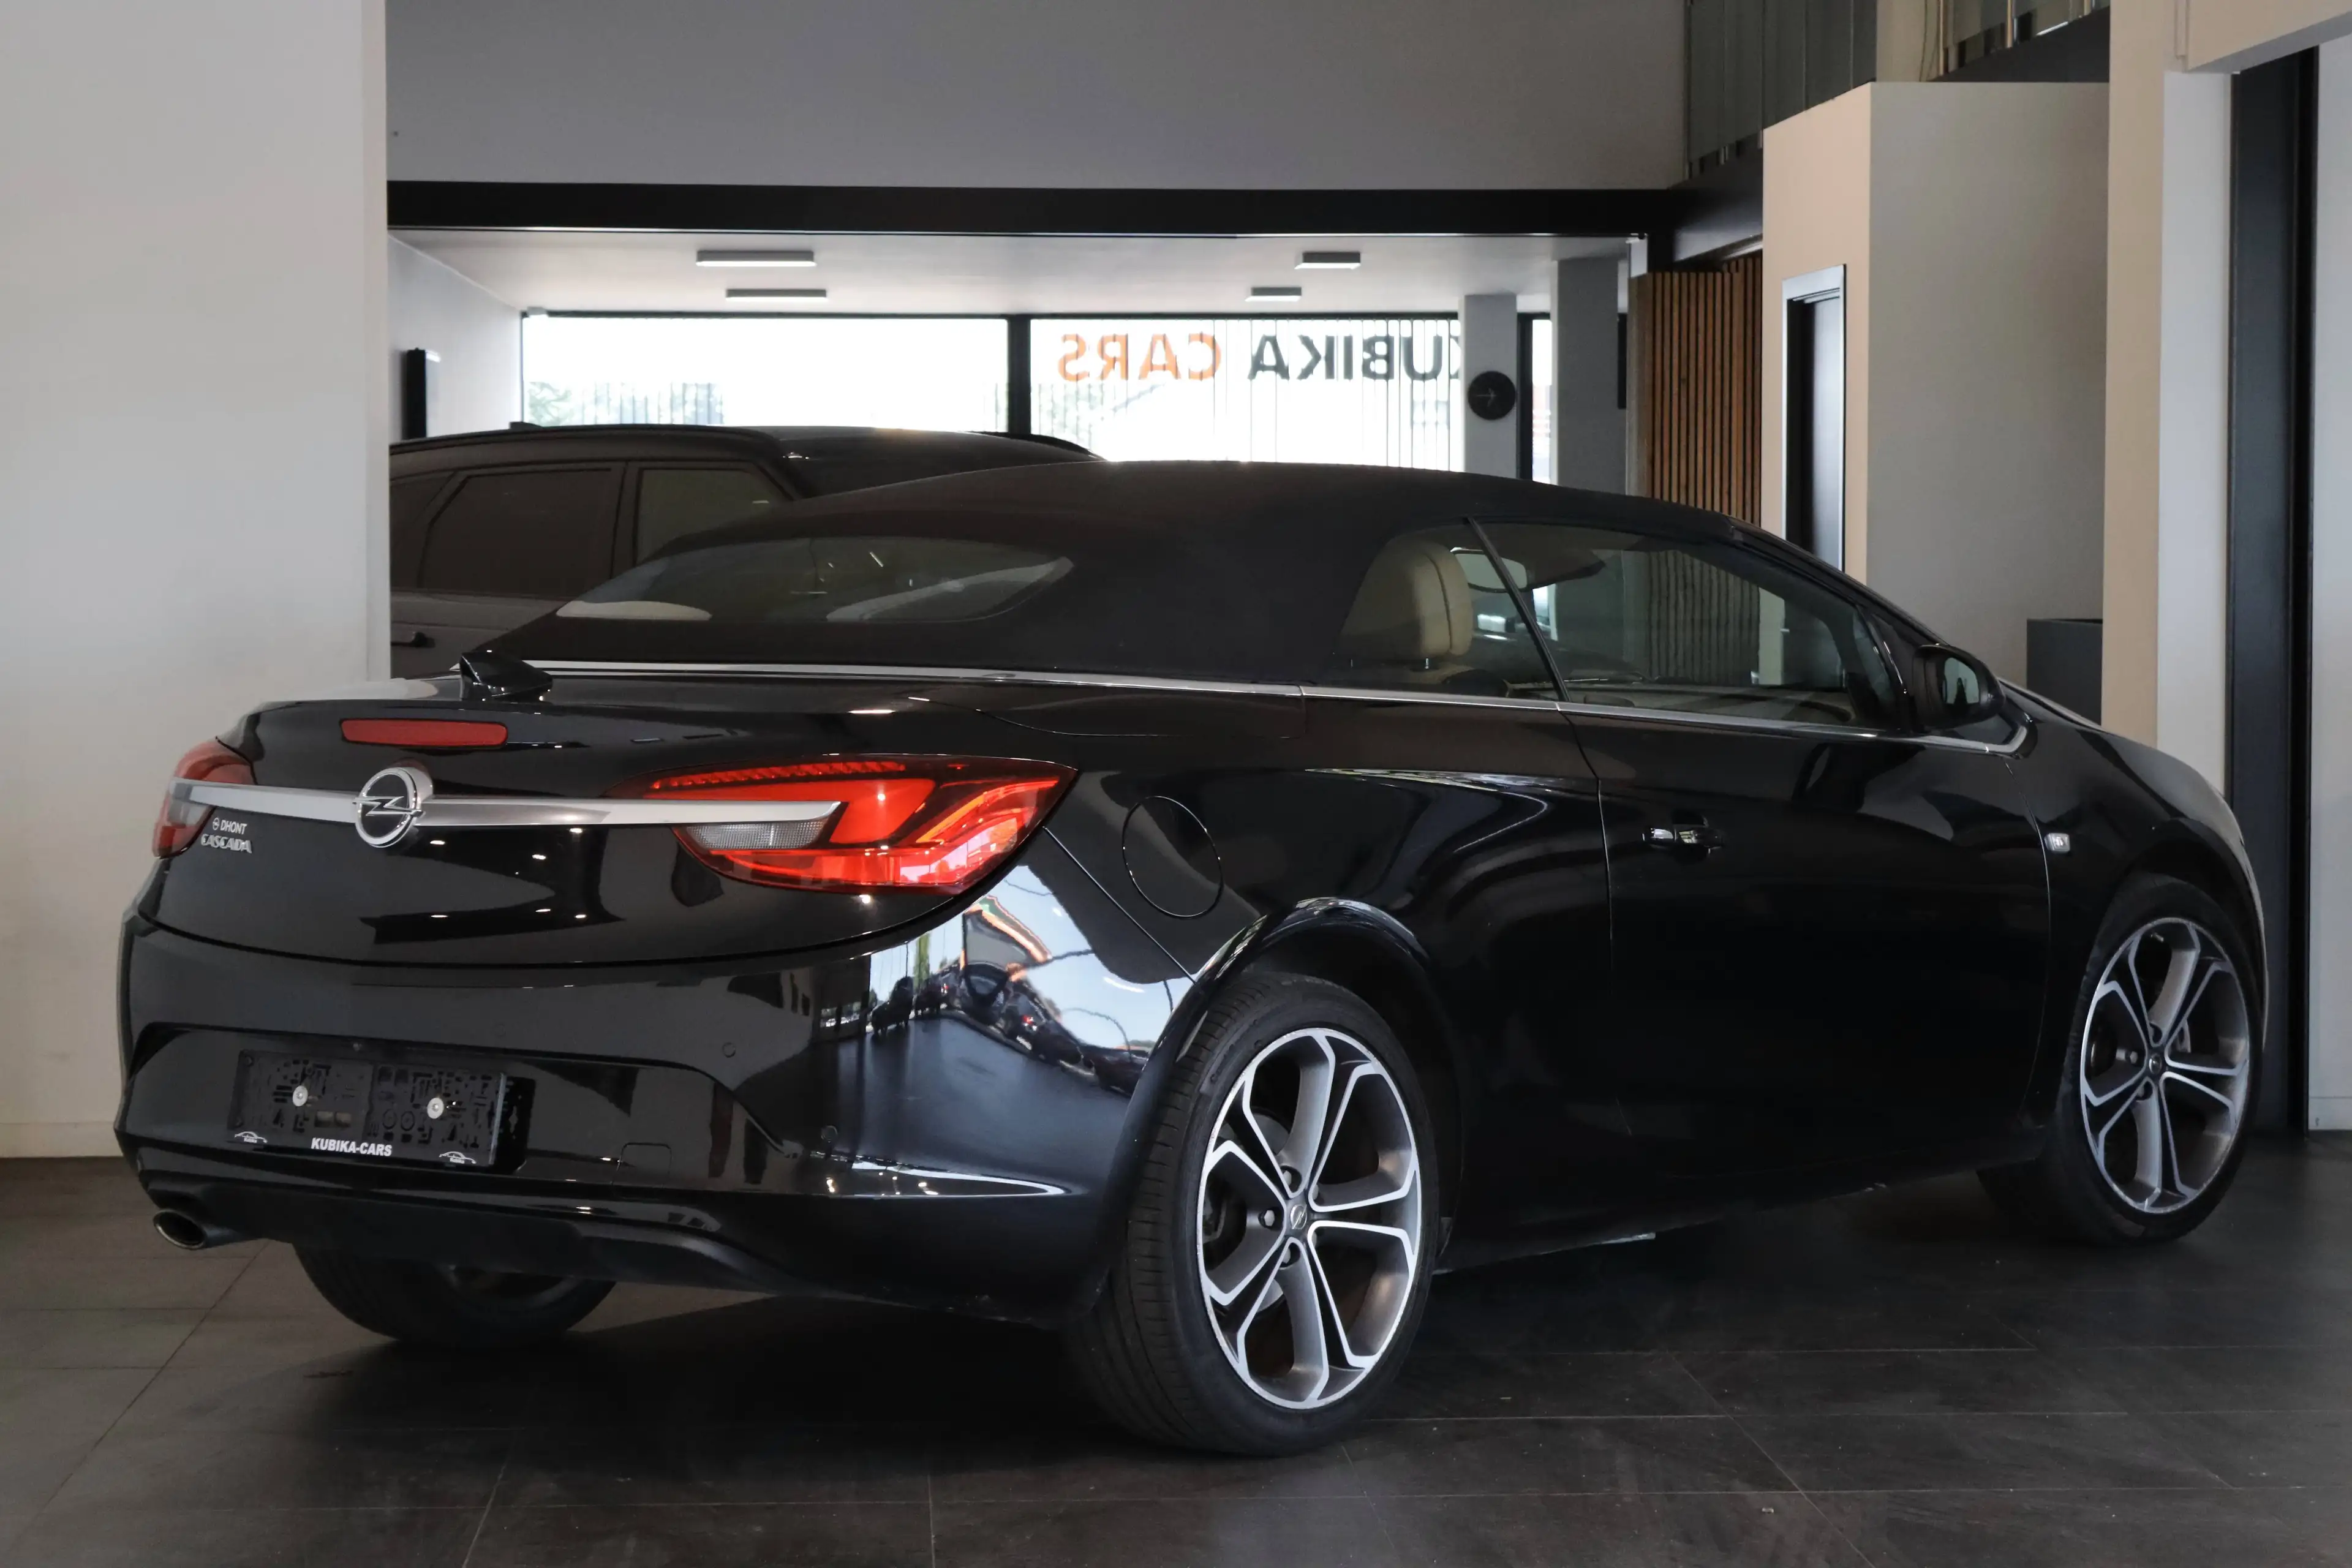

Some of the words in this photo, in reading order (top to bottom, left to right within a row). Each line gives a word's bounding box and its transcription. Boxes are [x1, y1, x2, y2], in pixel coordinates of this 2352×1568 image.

[220, 820, 247, 834] DHONT
[200, 834, 252, 854] CASCADA
[311, 1137, 393, 1157] KUBIKA-CARS
